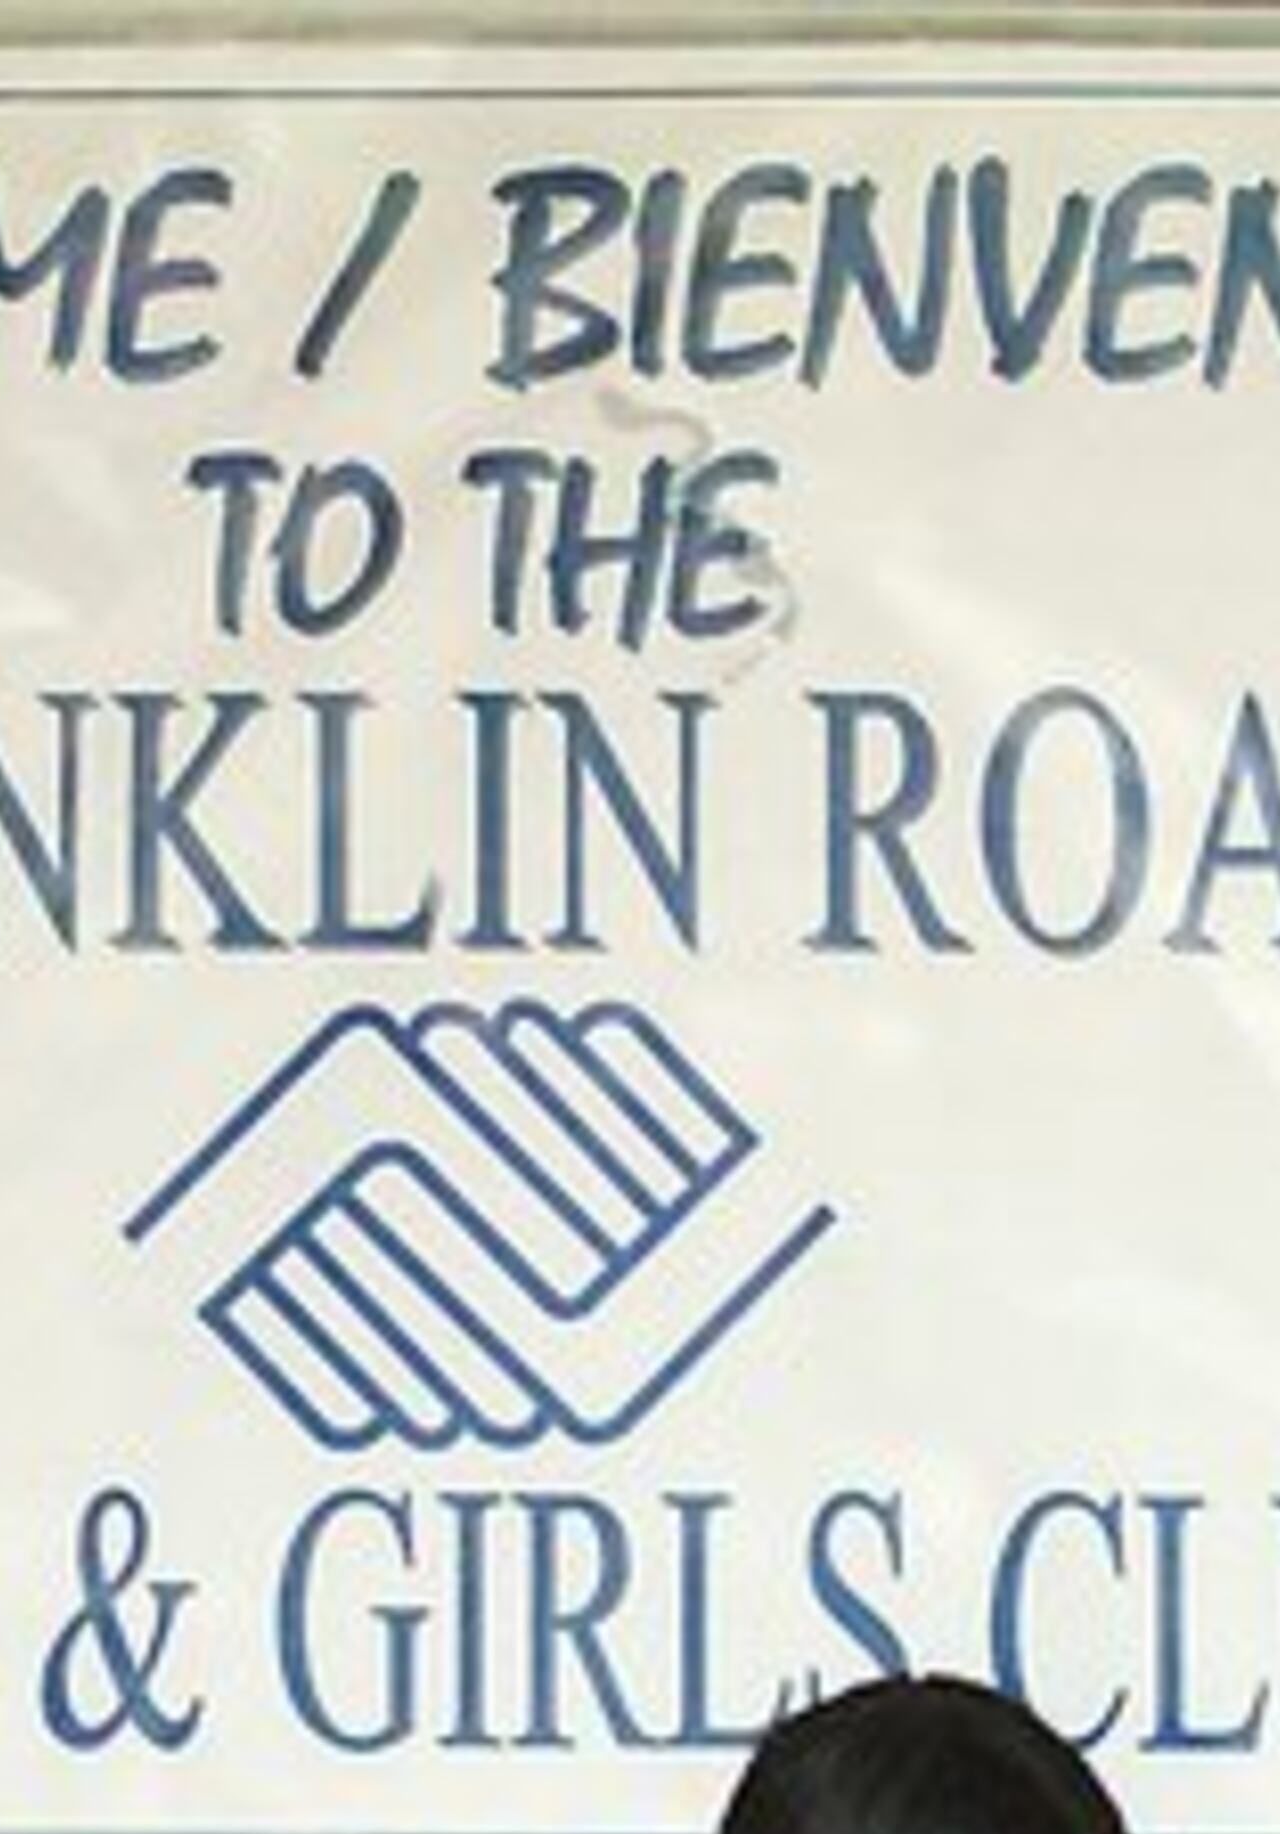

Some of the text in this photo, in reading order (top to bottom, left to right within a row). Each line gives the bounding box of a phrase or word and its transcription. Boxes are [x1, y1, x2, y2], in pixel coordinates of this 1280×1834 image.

[294, 170, 420, 379] /
[184, 448, 778, 650] TO THE
[40, 1486, 202, 1754] &
[275, 1488, 910, 1755] GIRLS
